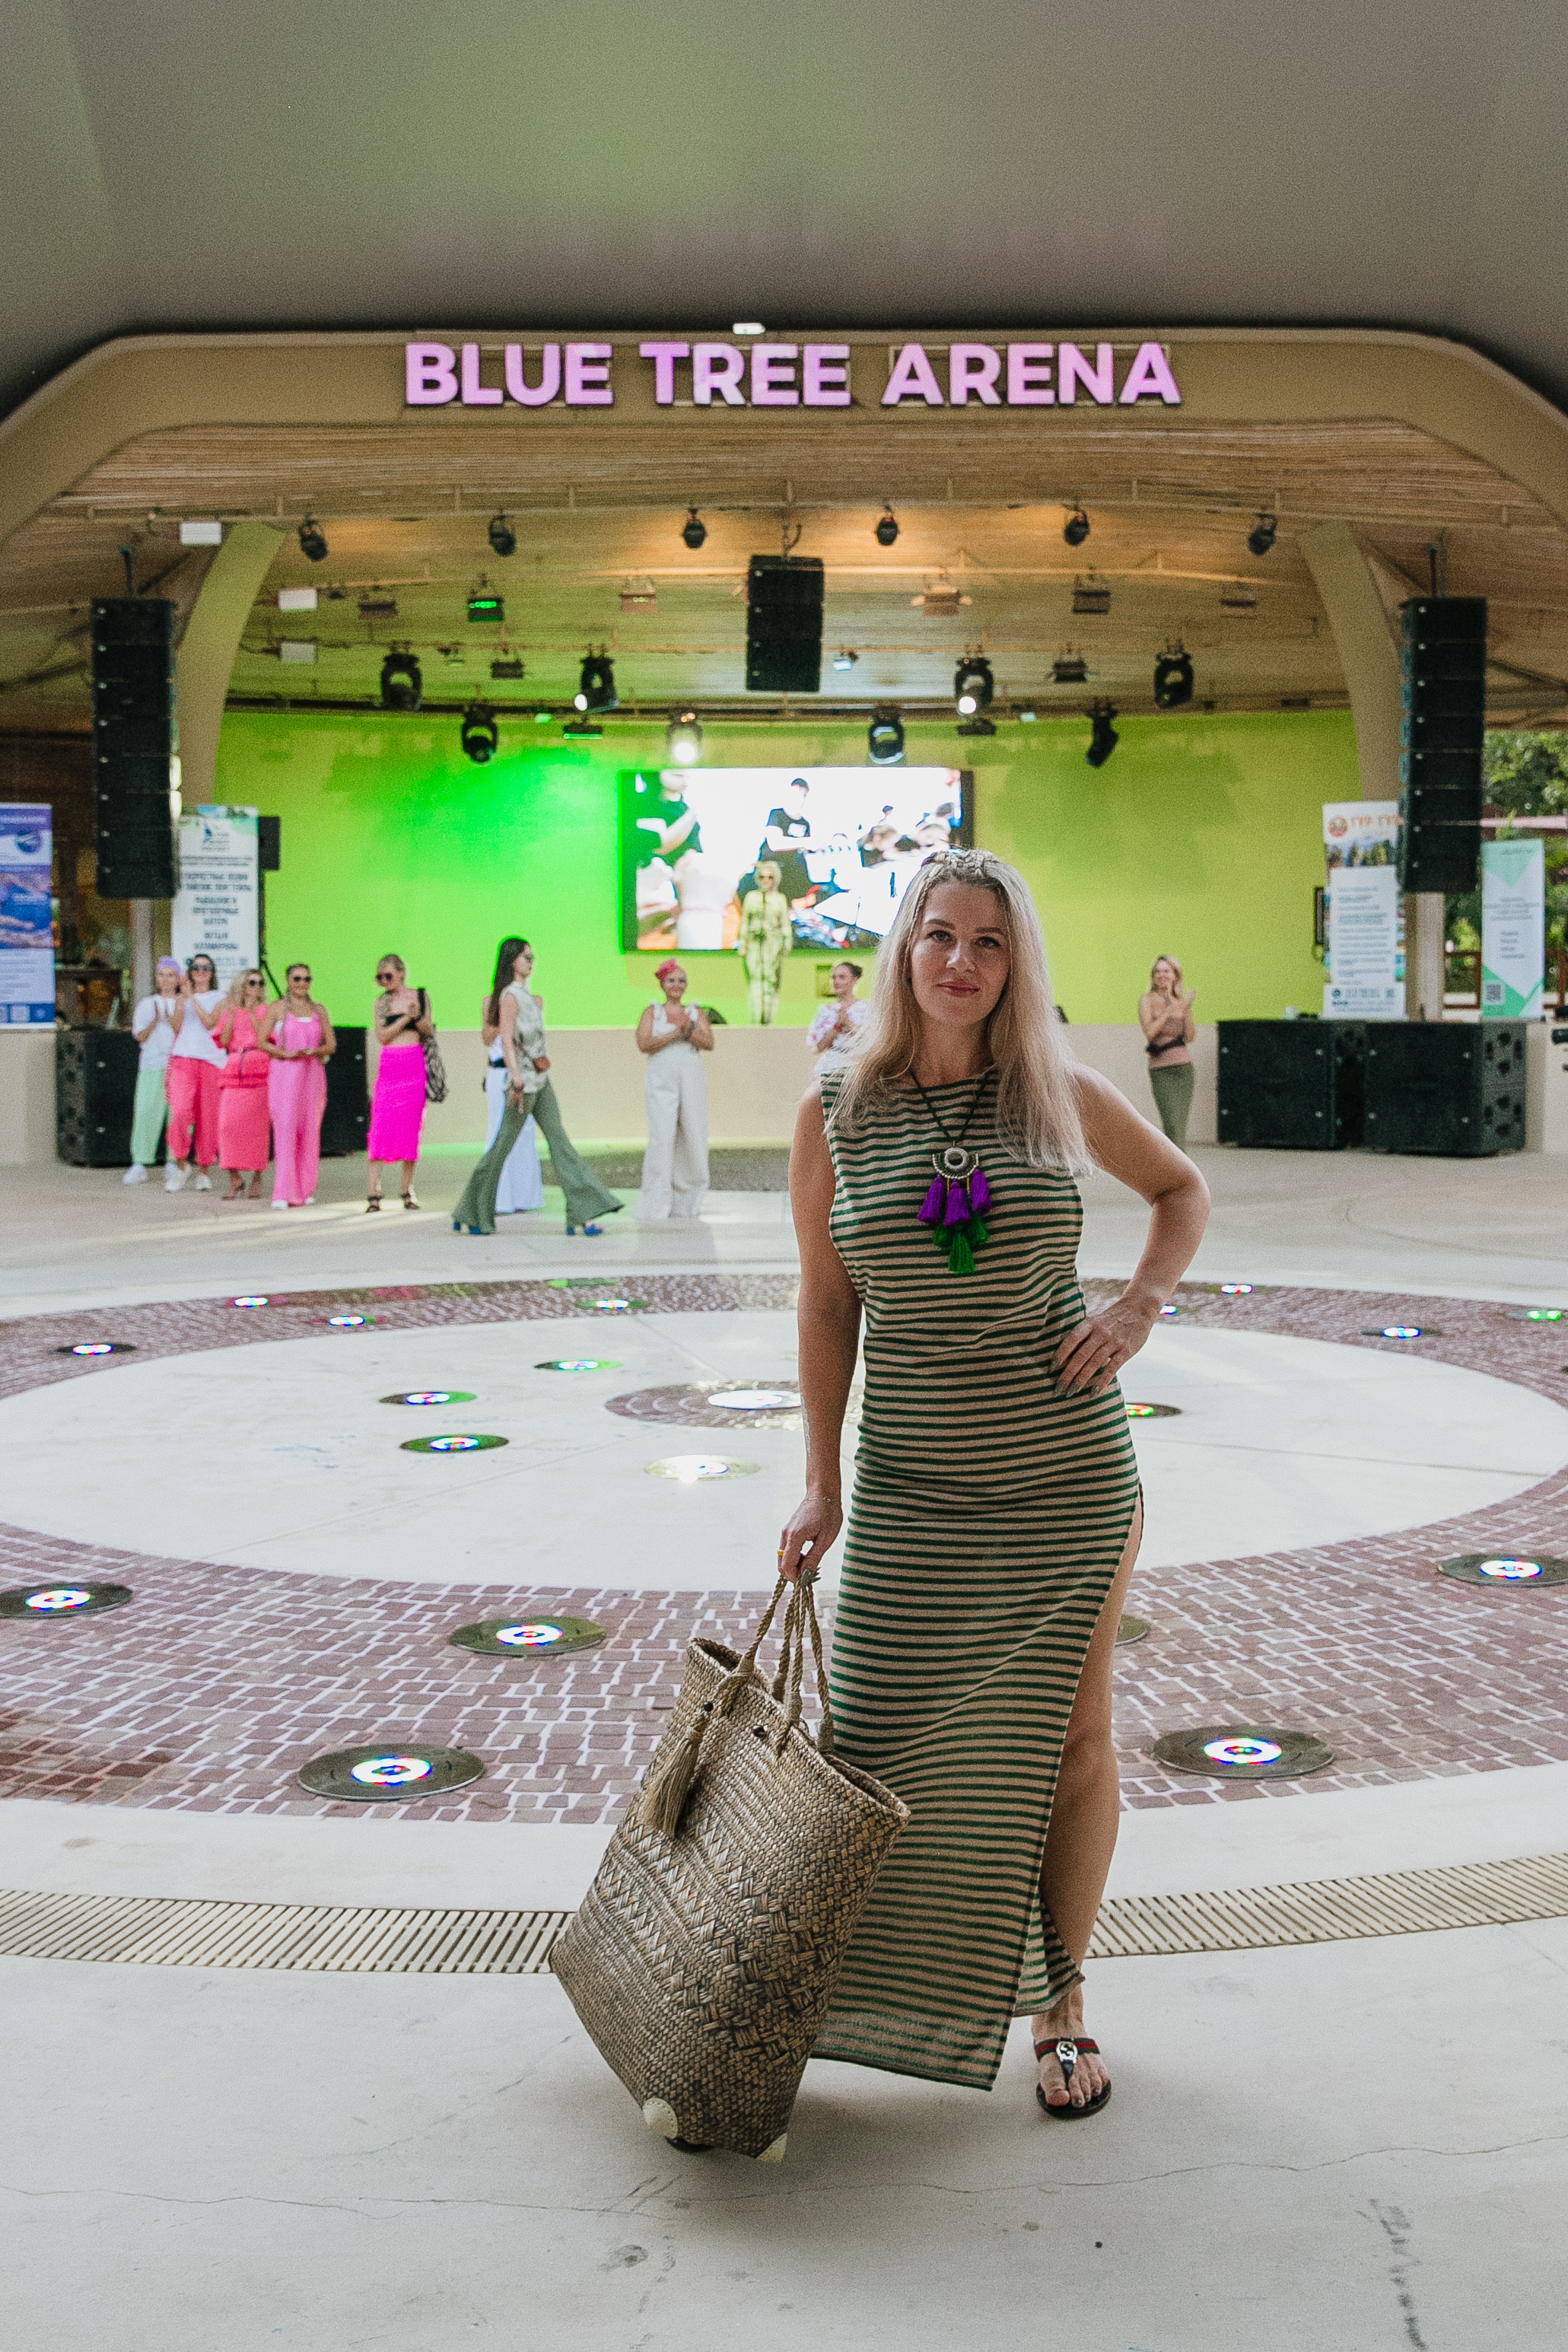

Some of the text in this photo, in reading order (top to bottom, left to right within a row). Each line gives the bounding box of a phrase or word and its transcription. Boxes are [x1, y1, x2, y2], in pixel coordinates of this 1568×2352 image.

[405, 342, 1182, 406] BLUE TREE ARENA
